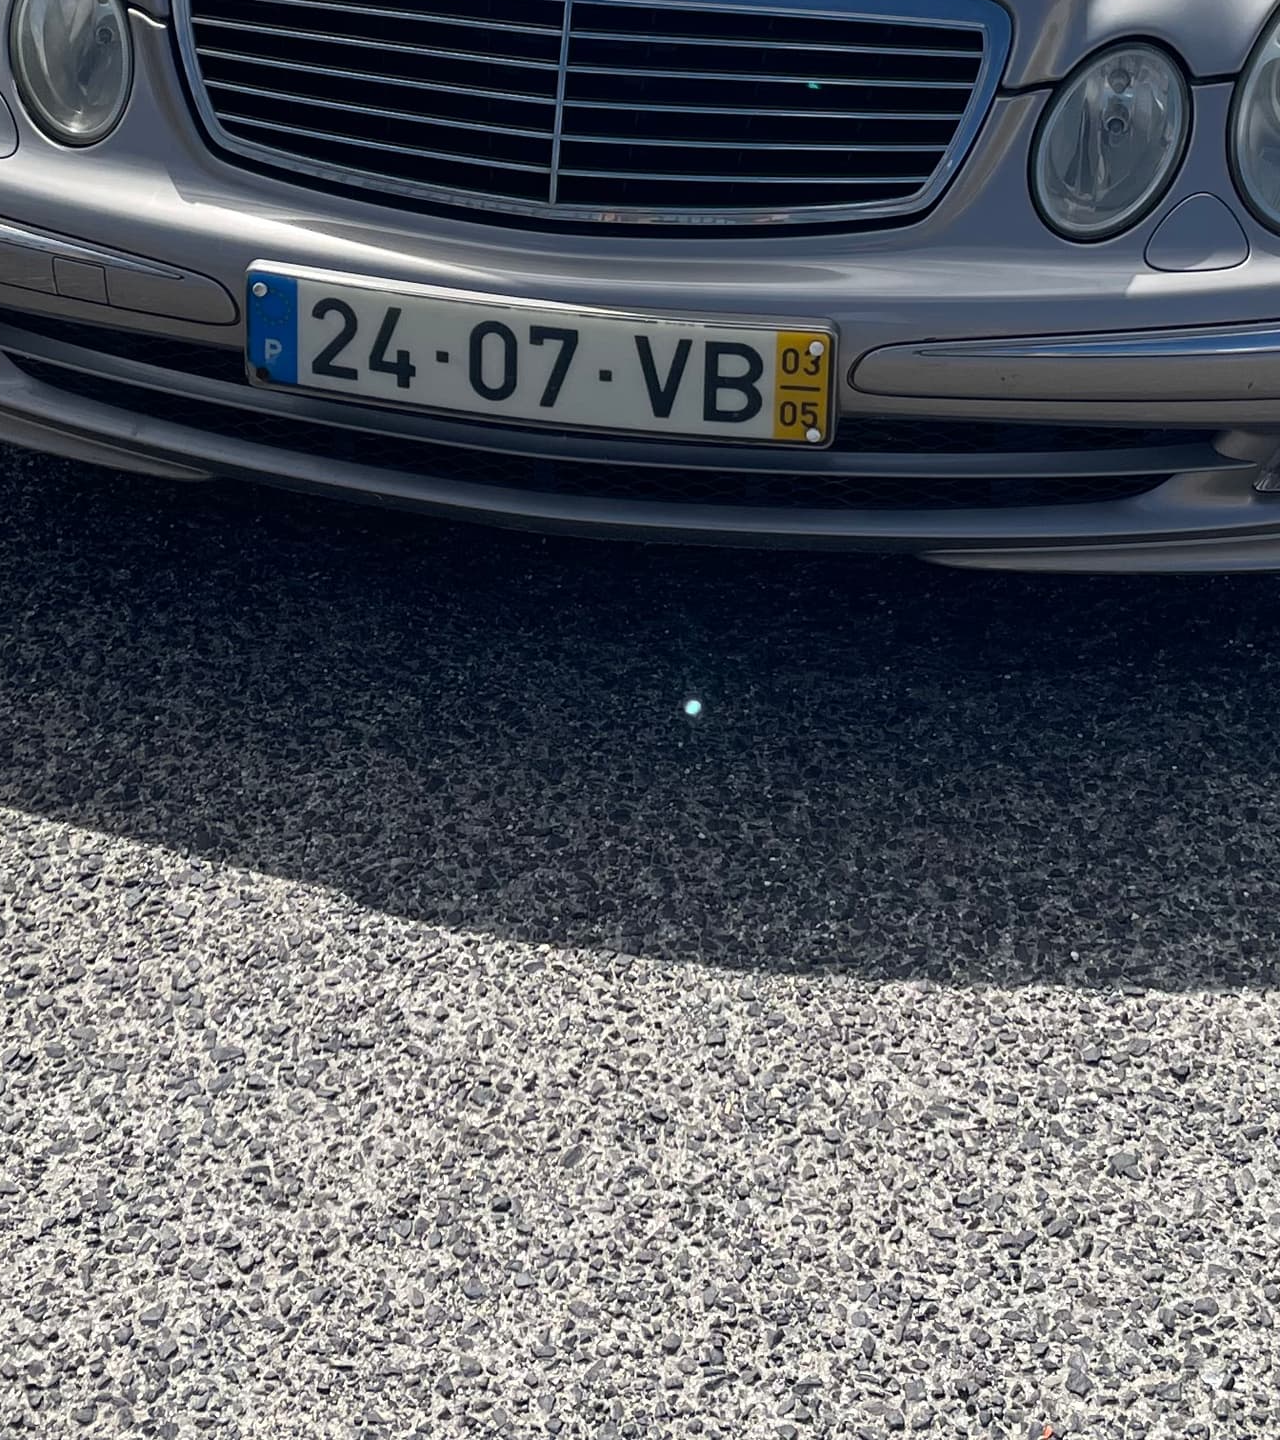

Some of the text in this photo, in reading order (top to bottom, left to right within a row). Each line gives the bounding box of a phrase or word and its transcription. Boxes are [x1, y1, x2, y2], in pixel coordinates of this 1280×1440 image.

[264, 338, 283, 362] P
[782, 348, 821, 376] 03
[780, 401, 818, 429] 05
